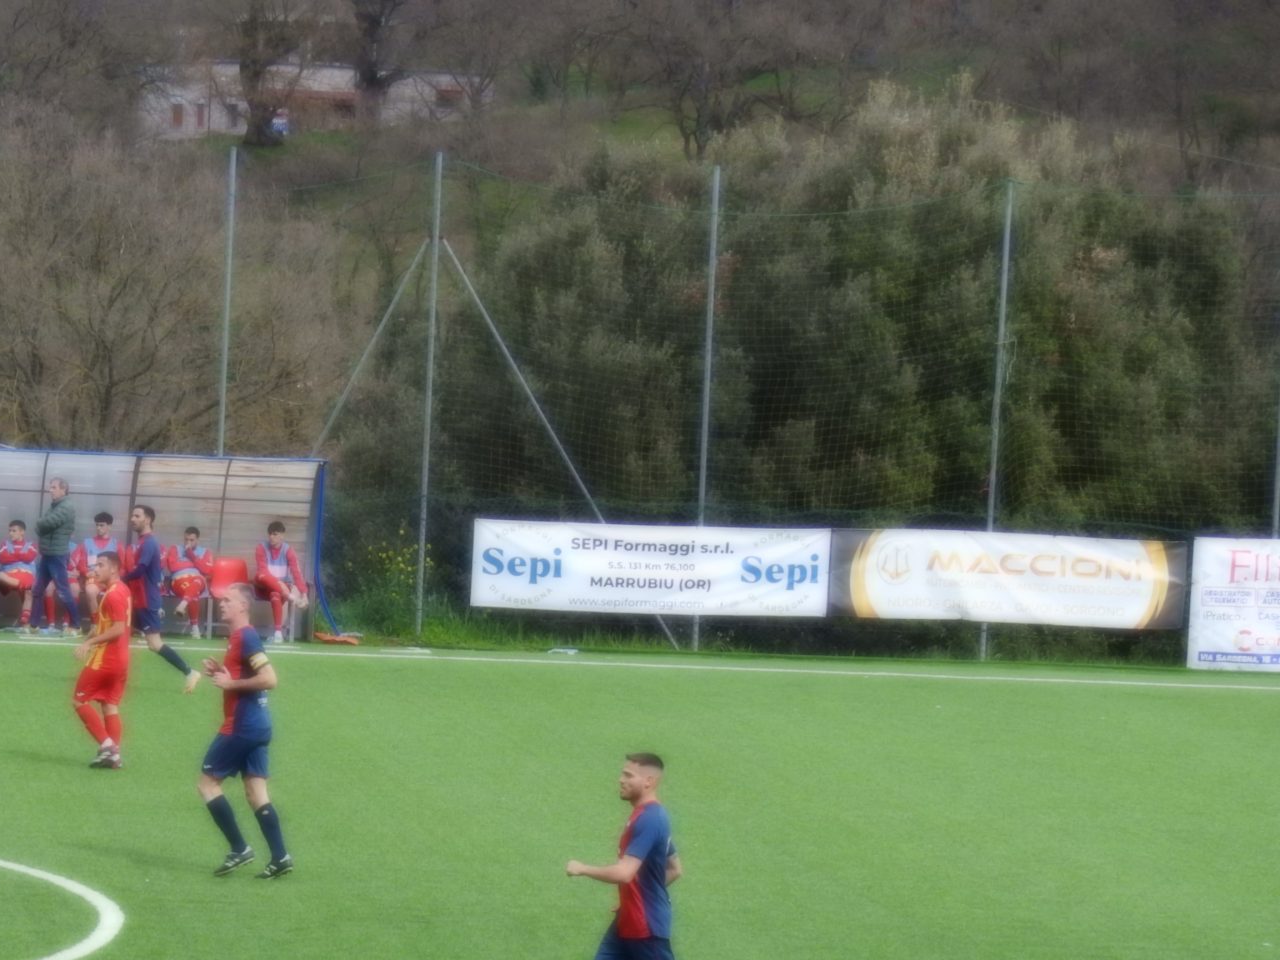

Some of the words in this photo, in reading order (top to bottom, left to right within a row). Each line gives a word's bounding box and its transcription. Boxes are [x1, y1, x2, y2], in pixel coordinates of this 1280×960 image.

[570, 537, 608, 551] SEPI
[613, 539, 696, 557] Formaggi
[700, 541, 735, 555] s.r.l.
[481, 547, 562, 585] Sepi
[607, 561, 626, 570] S.S.
[628, 562, 642, 570] 131
[644, 562, 663, 571] Km
[740, 553, 820, 591] Sepi
[926, 550, 1142, 581] MACCIONI
[589, 576, 675, 590] MARRUBIU
[679, 578, 712, 593] (OR)
[567, 597, 704, 611] www.sepiformaggi.com
